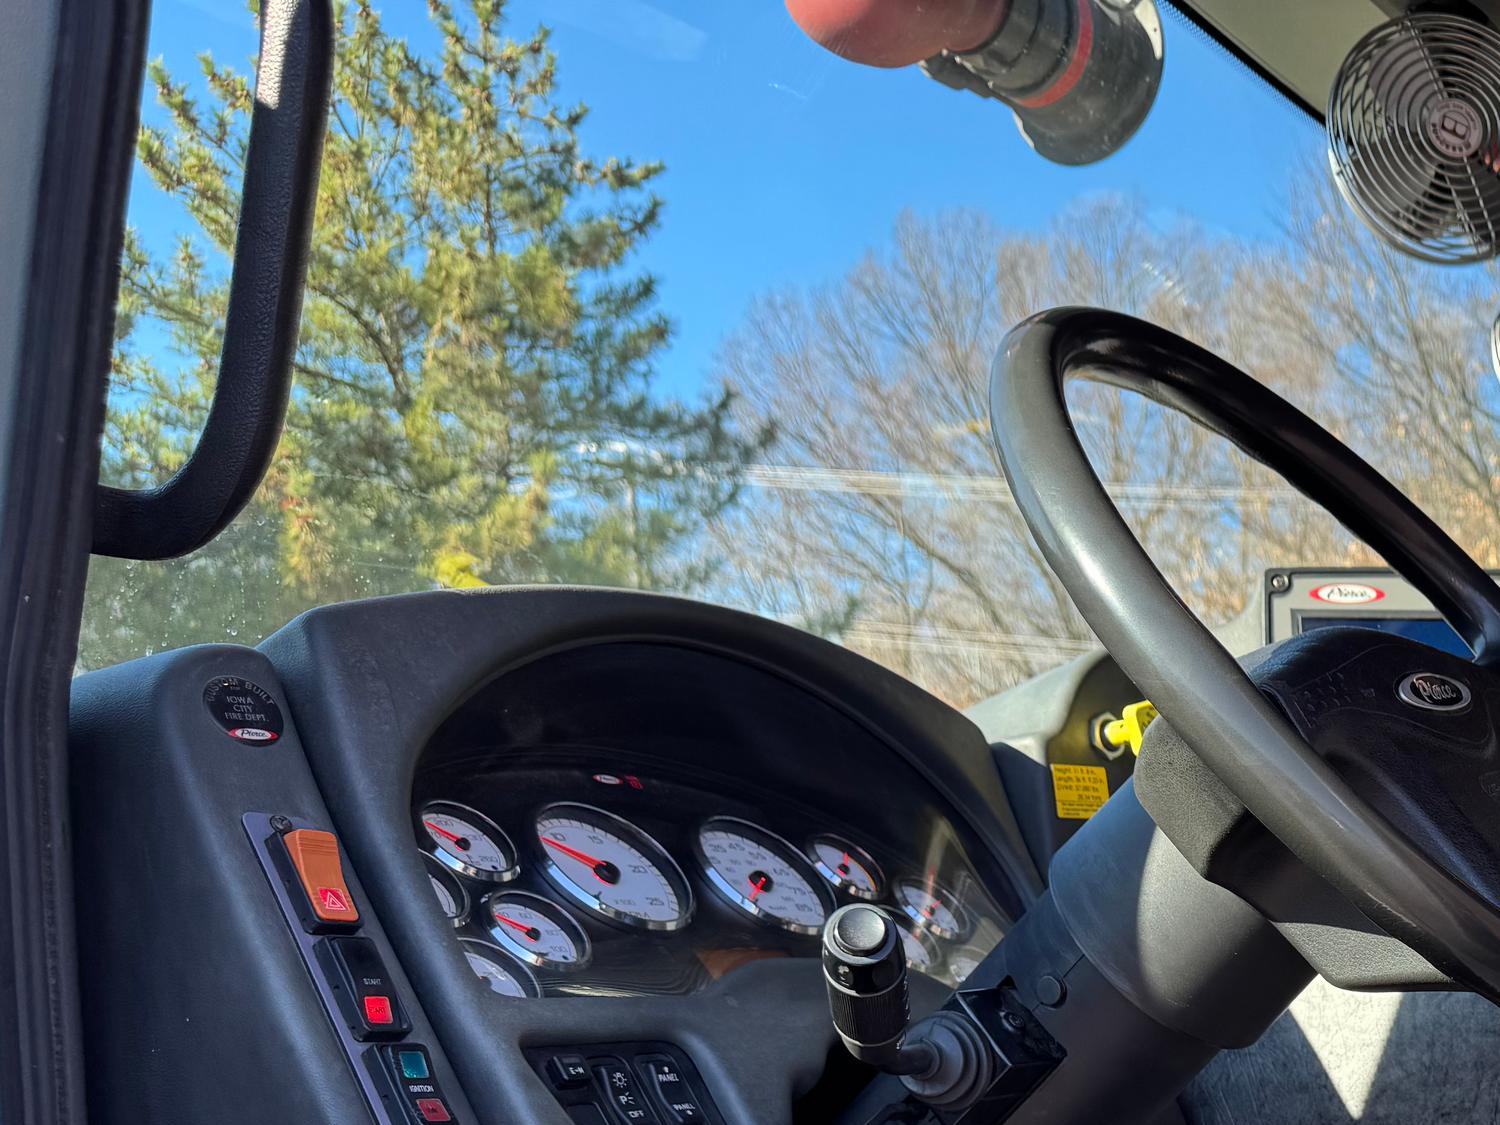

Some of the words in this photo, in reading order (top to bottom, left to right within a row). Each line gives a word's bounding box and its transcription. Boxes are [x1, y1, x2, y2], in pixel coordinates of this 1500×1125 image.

[245, 682, 275, 705] BUILT
[226, 696, 254, 705] IOWA
[233, 704, 252, 713] CITY
[224, 712, 242, 721] FIRE
[240, 729, 266, 738] Pierce
[658, 1073, 679, 1083] PANEL
[628, 1110, 645, 1118] OFF
